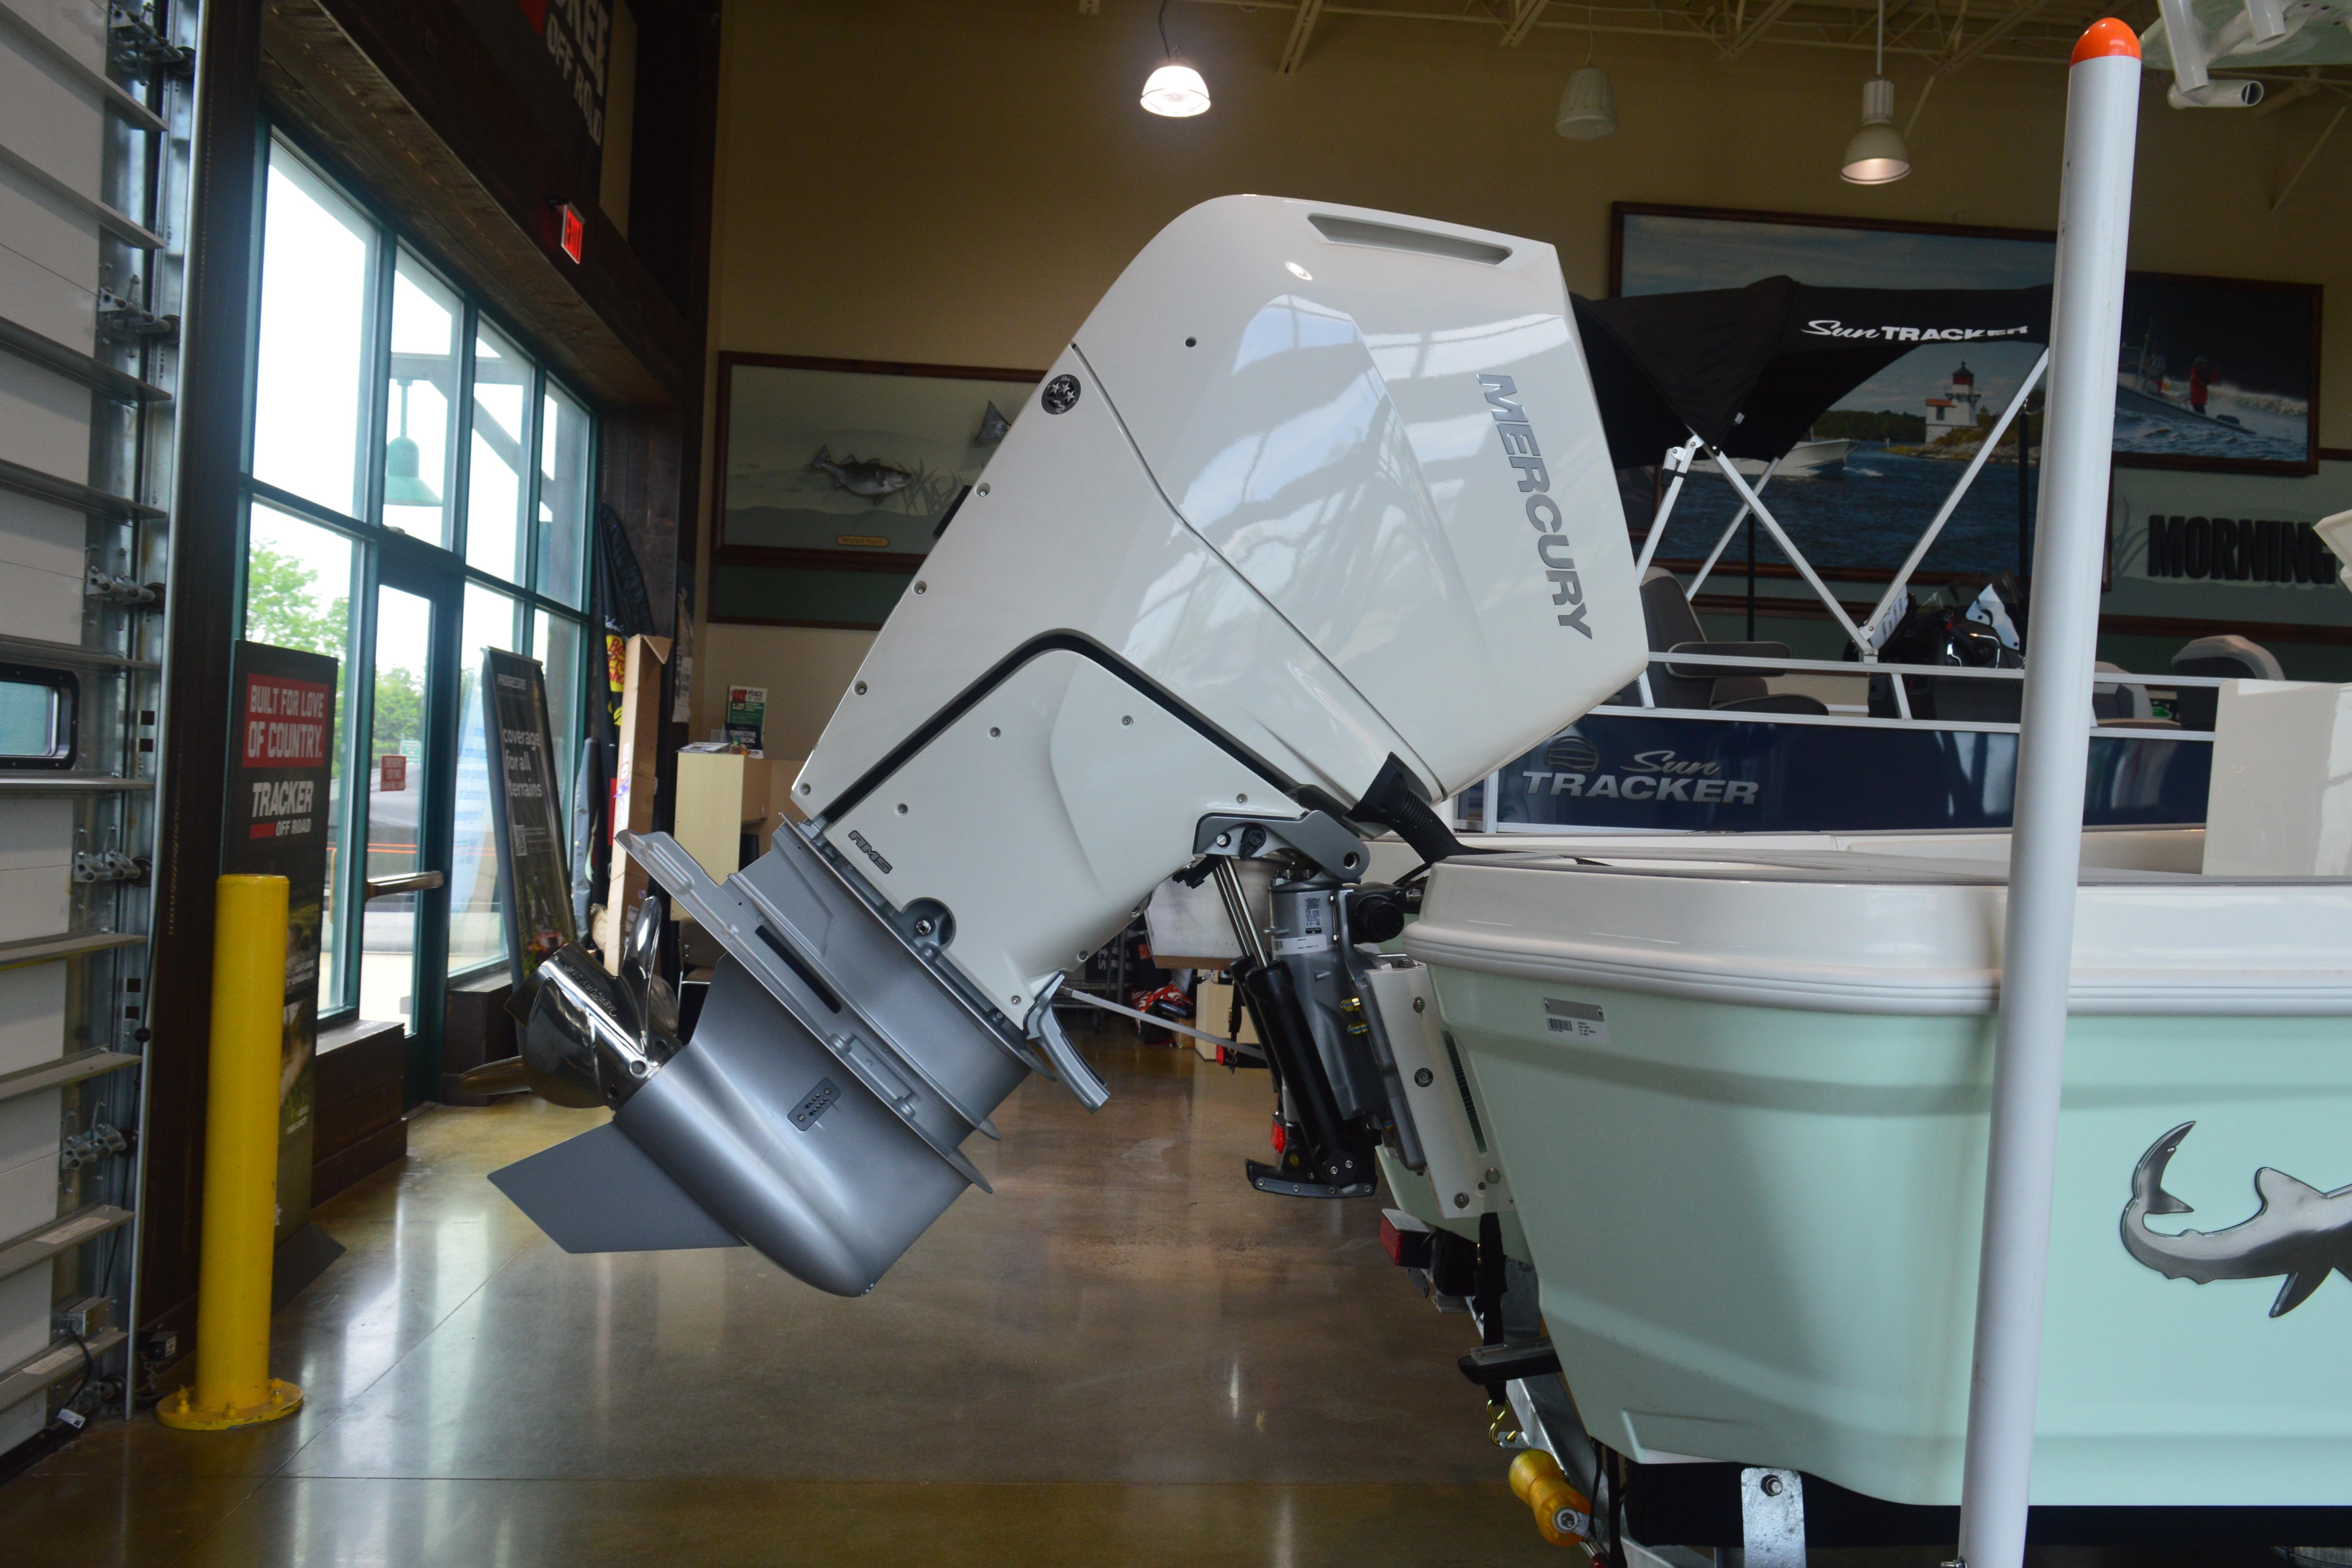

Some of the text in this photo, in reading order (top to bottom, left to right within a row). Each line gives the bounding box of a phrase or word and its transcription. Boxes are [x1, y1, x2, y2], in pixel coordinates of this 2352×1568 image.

[546, 12, 603, 146] OFF ROAD
[1801, 319, 2029, 341] Sun TRACKER
[1476, 373, 1593, 639] MERCURY
[250, 685, 324, 717] BUILT FOR LOVE
[247, 721, 322, 758] OF COUNTRY.
[503, 728, 541, 751] coverage
[506, 752, 531, 771] for all
[1620, 750, 1720, 776] Sun
[252, 781, 314, 817] TRACKER
[509, 779, 542, 798] terrains
[1522, 771, 1759, 805] TRACKER
[275, 818, 312, 837] OFF ROAD
[581, 980, 617, 1013] MERCURY
